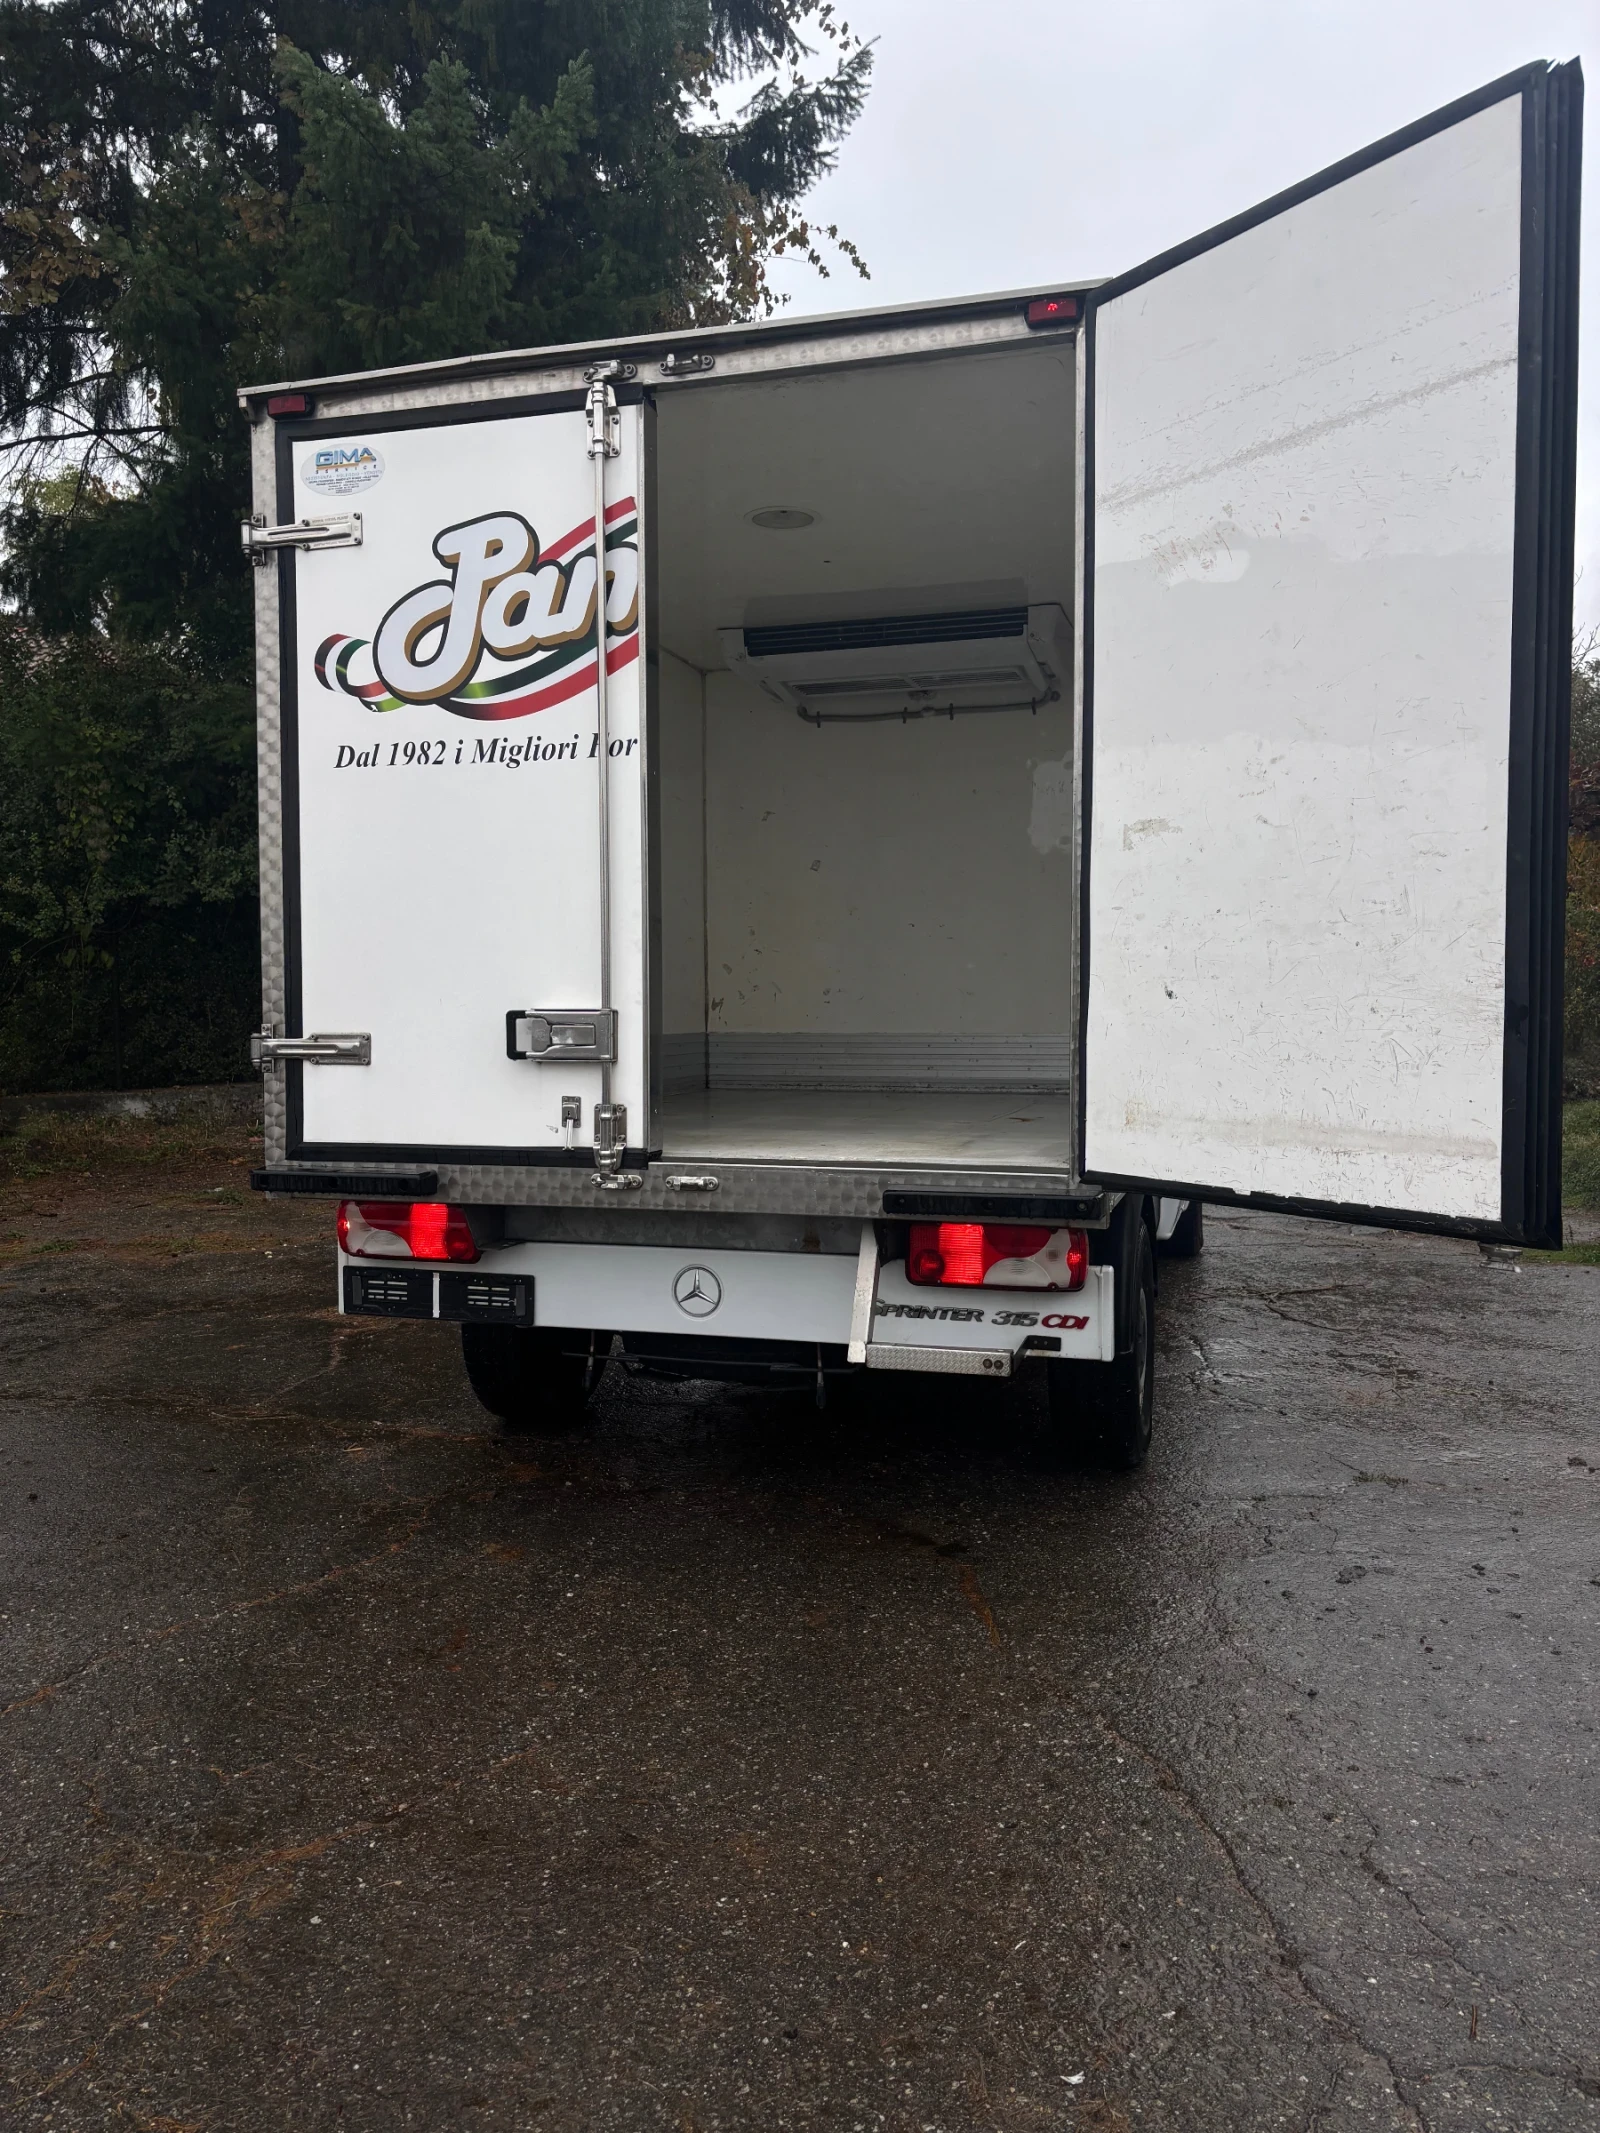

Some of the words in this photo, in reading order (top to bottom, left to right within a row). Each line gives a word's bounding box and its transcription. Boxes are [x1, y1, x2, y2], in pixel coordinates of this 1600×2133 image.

[315, 447, 377, 467] GIMA
[333, 742, 380, 768] Dal
[386, 739, 447, 766] 1982
[454, 739, 464, 765] i
[470, 733, 579, 769] Migliori
[991, 1310, 1040, 1328] 315
[1041, 1313, 1090, 1331] CDI
